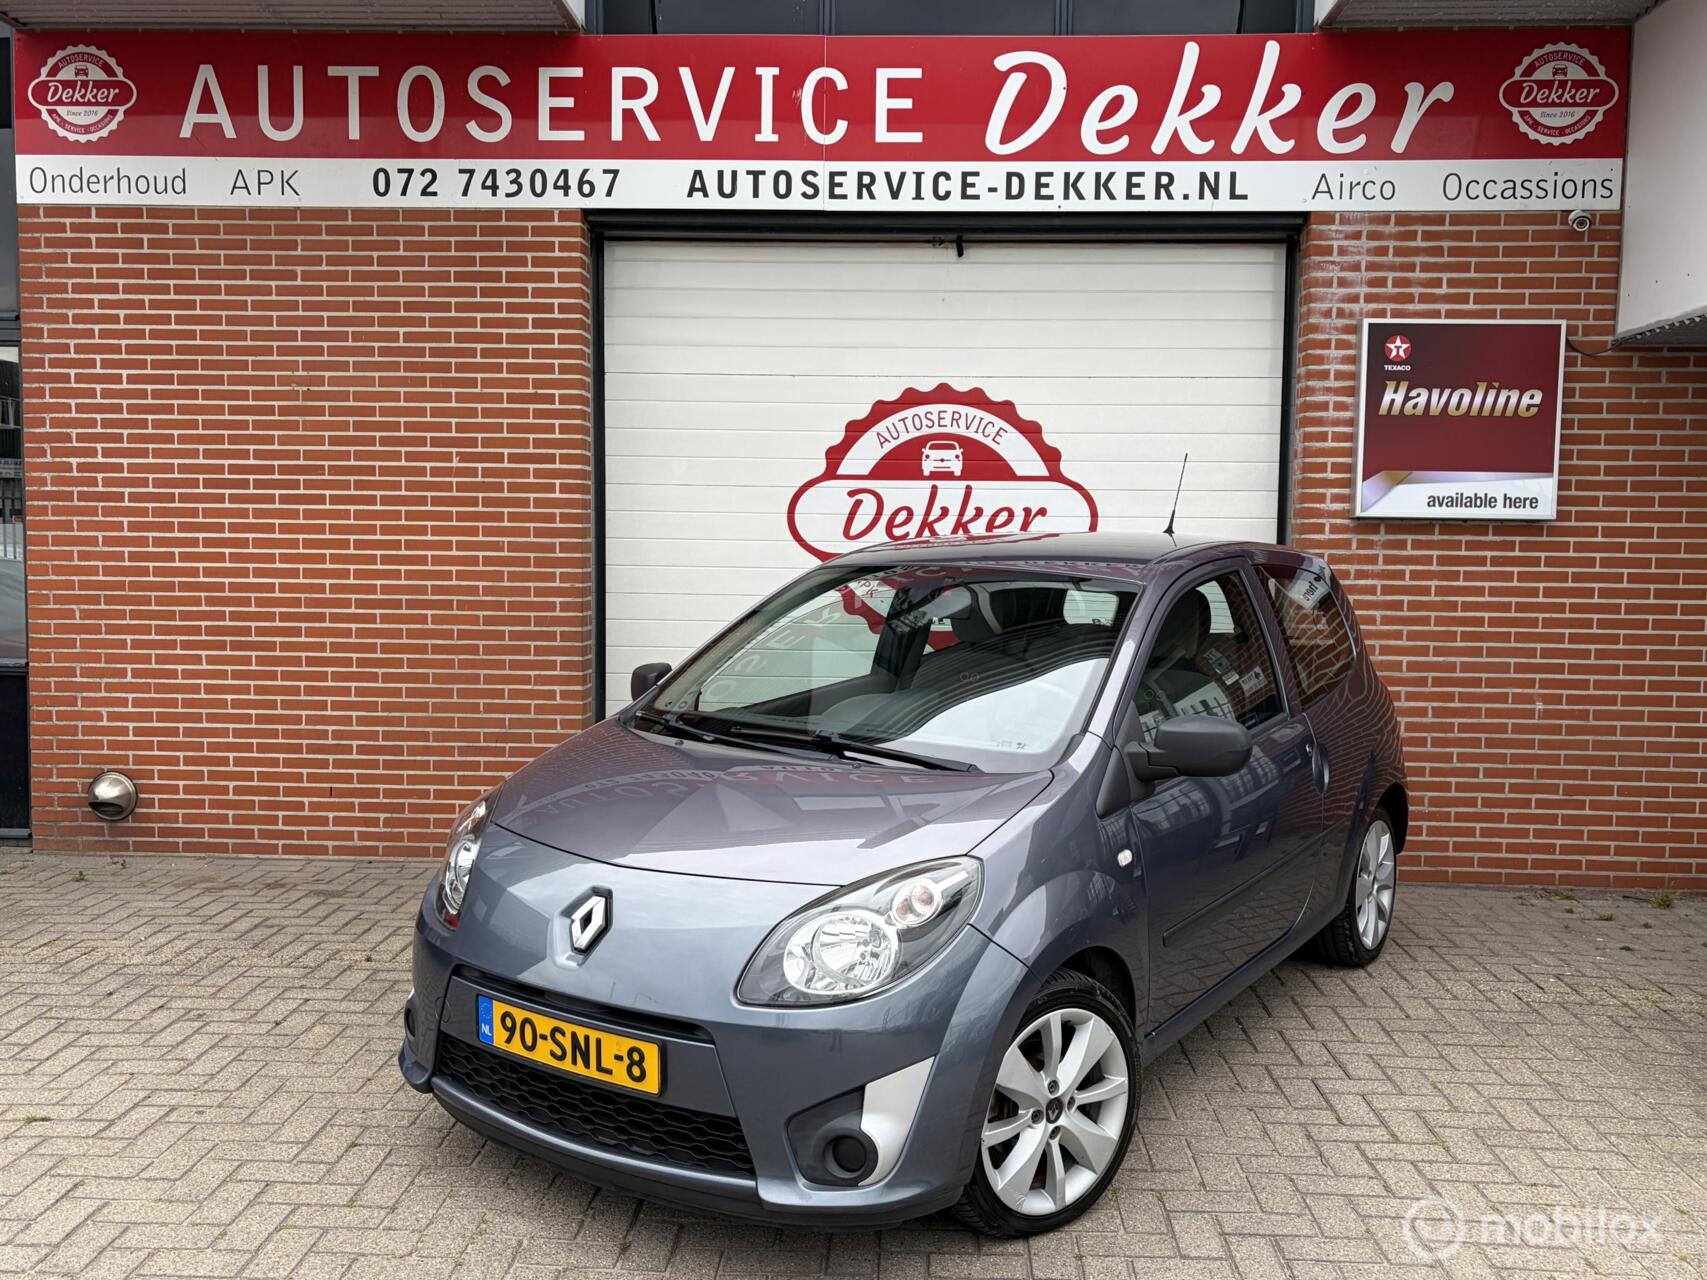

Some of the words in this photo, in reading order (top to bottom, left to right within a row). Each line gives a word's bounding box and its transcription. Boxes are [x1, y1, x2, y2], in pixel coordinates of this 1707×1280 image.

[58, 53, 105, 68] AUTOSERVICE
[1534, 51, 1586, 68] AUTOSERVICE
[47, 79, 120, 103] Dekker
[180, 63, 924, 145] AUTOSERVICE
[985, 40, 1455, 155] Dekker
[1520, 80, 1600, 103] Dekker
[64, 123, 85, 134] SERVICE
[1537, 126, 1560, 137] SERVICE
[29, 167, 187, 196] Onderhoud
[230, 169, 300, 197] APK
[373, 168, 438, 198] 072
[459, 168, 620, 198] 7430467
[687, 169, 1249, 201] AUTOSERVICE-DEKKER.NL
[1311, 173, 1396, 201] Airco
[1442, 171, 1614, 200] Occassions
[1384, 364, 1411, 372] TEXACO
[1378, 380, 1543, 418] Havoline
[875, 410, 1008, 449] AUTOSERVICE
[842, 484, 1047, 541] Dekker
[1427, 493, 1498, 509] available
[1503, 493, 1539, 510] here
[481, 1023, 493, 1037] NL
[500, 1010, 647, 1083] 90-SNL-8
